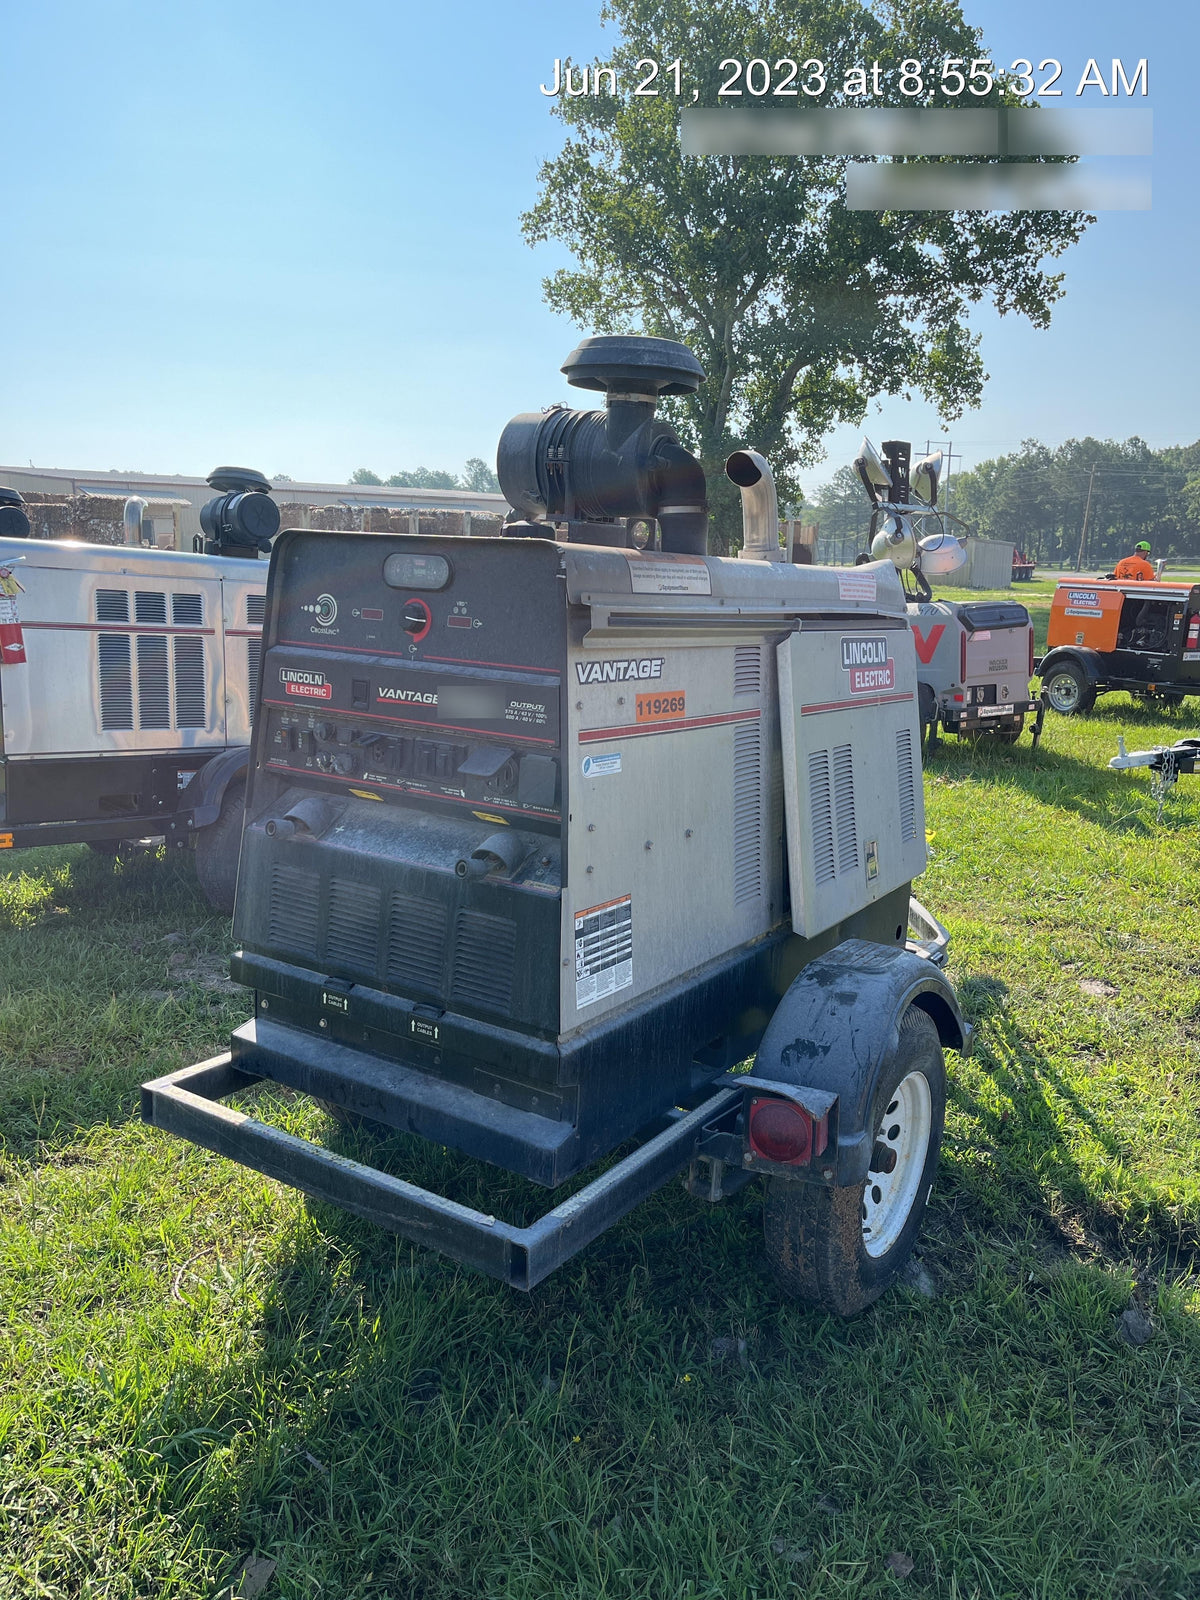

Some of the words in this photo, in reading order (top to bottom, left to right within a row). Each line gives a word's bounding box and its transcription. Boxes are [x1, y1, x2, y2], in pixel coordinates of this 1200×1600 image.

[1068, 592, 1097, 600] LINCOLN
[843, 641, 886, 665] LINCOLN
[281, 670, 323, 685] LINCOLN
[575, 658, 662, 684] VANTAGE
[855, 669, 891, 689] ELECTRIC
[290, 684, 327, 697] ELECTRIC
[378, 686, 438, 705] VANTAGE
[510, 701, 543, 711] OUTPUT
[637, 696, 685, 716] 119269
